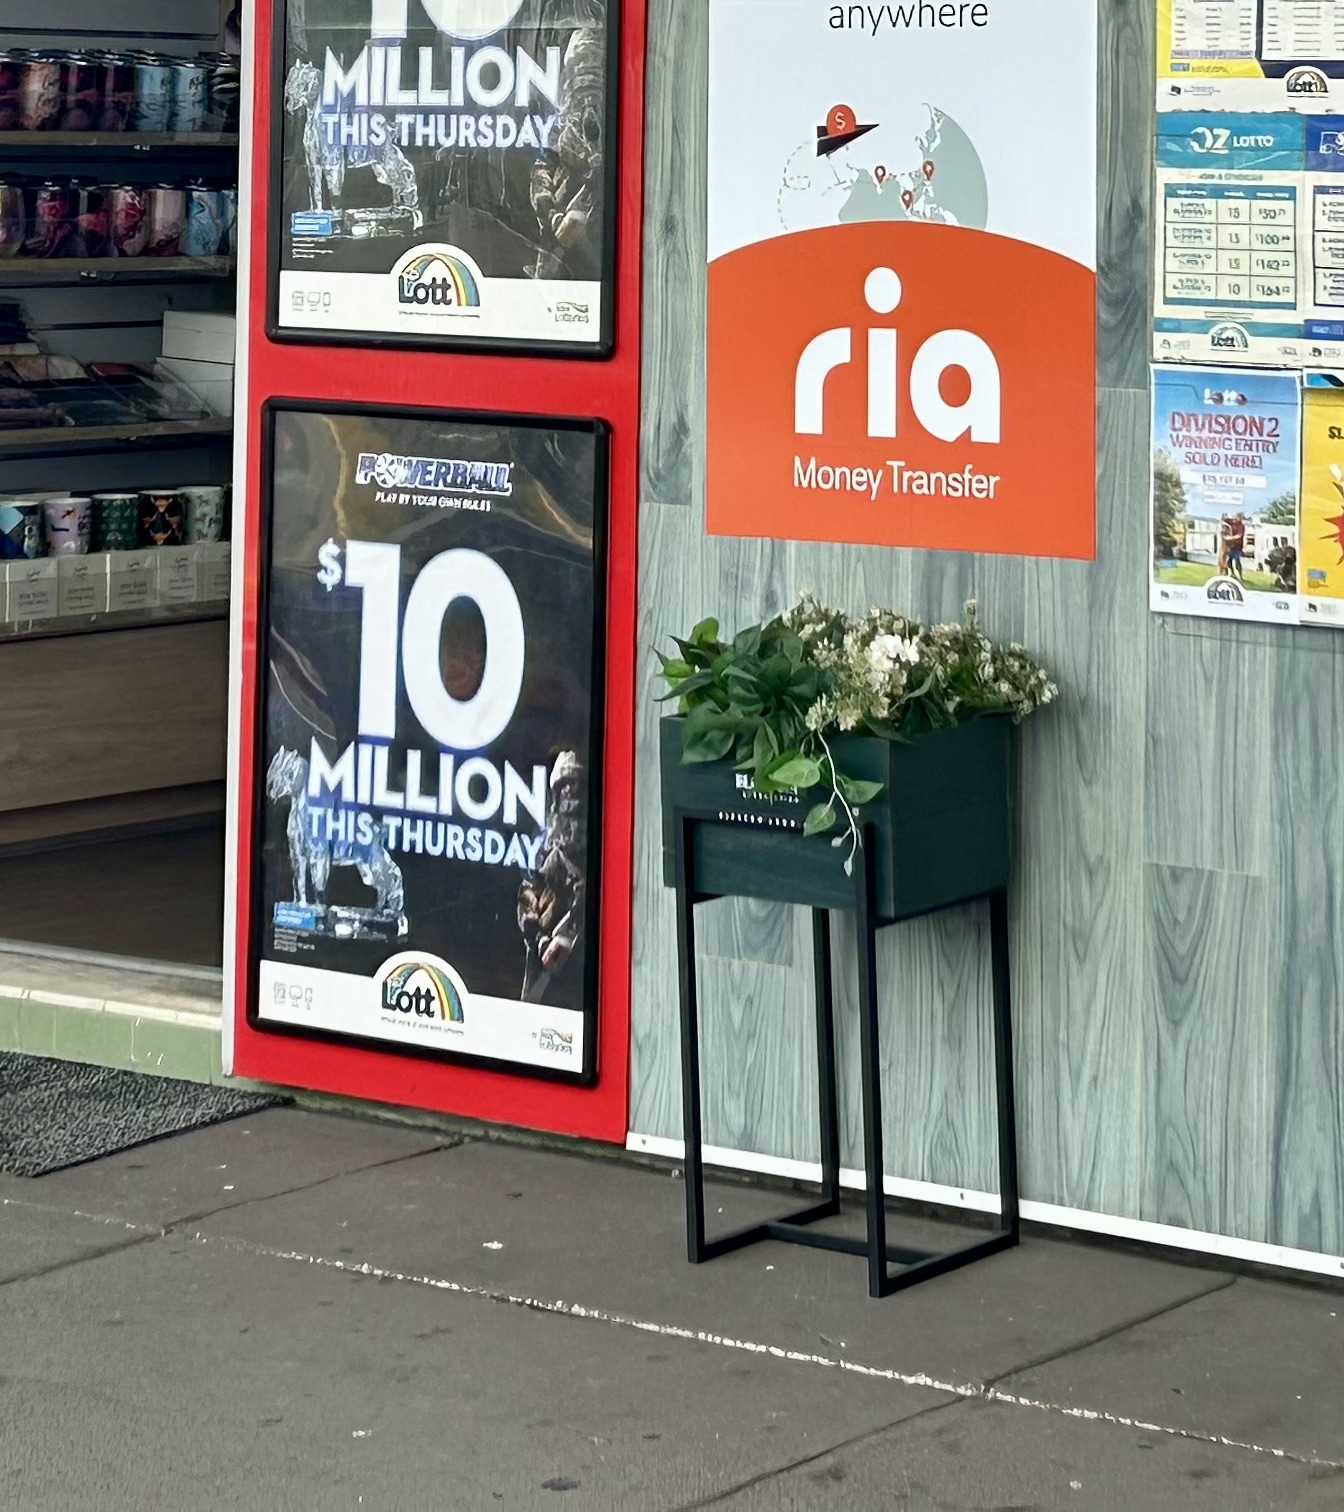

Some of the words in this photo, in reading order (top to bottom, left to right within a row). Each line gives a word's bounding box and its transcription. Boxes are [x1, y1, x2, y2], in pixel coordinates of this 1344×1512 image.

[321, 44, 562, 113] MILLION
[320, 112, 388, 148] THIS
[394, 111, 560, 149] THURSDAY
[1188, 126, 1232, 155] OZ
[1232, 134, 1276, 148] LOTTO
[397, 275, 453, 307] Lott
[794, 266, 1001, 445] ria
[1170, 410, 1265, 438] DIVISION
[1265, 416, 1281, 438] 2
[355, 453, 515, 497] POWERBALL
[792, 454, 883, 502] Money
[885, 459, 1001, 500] Transfer
[1183, 451, 1221, 467] SOLD
[316, 537, 525, 750] $10
[307, 735, 548, 830] MILLION
[307, 805, 374, 846] THIS
[381, 814, 546, 872] THURSDAY
[381, 979, 436, 1019] Lott
